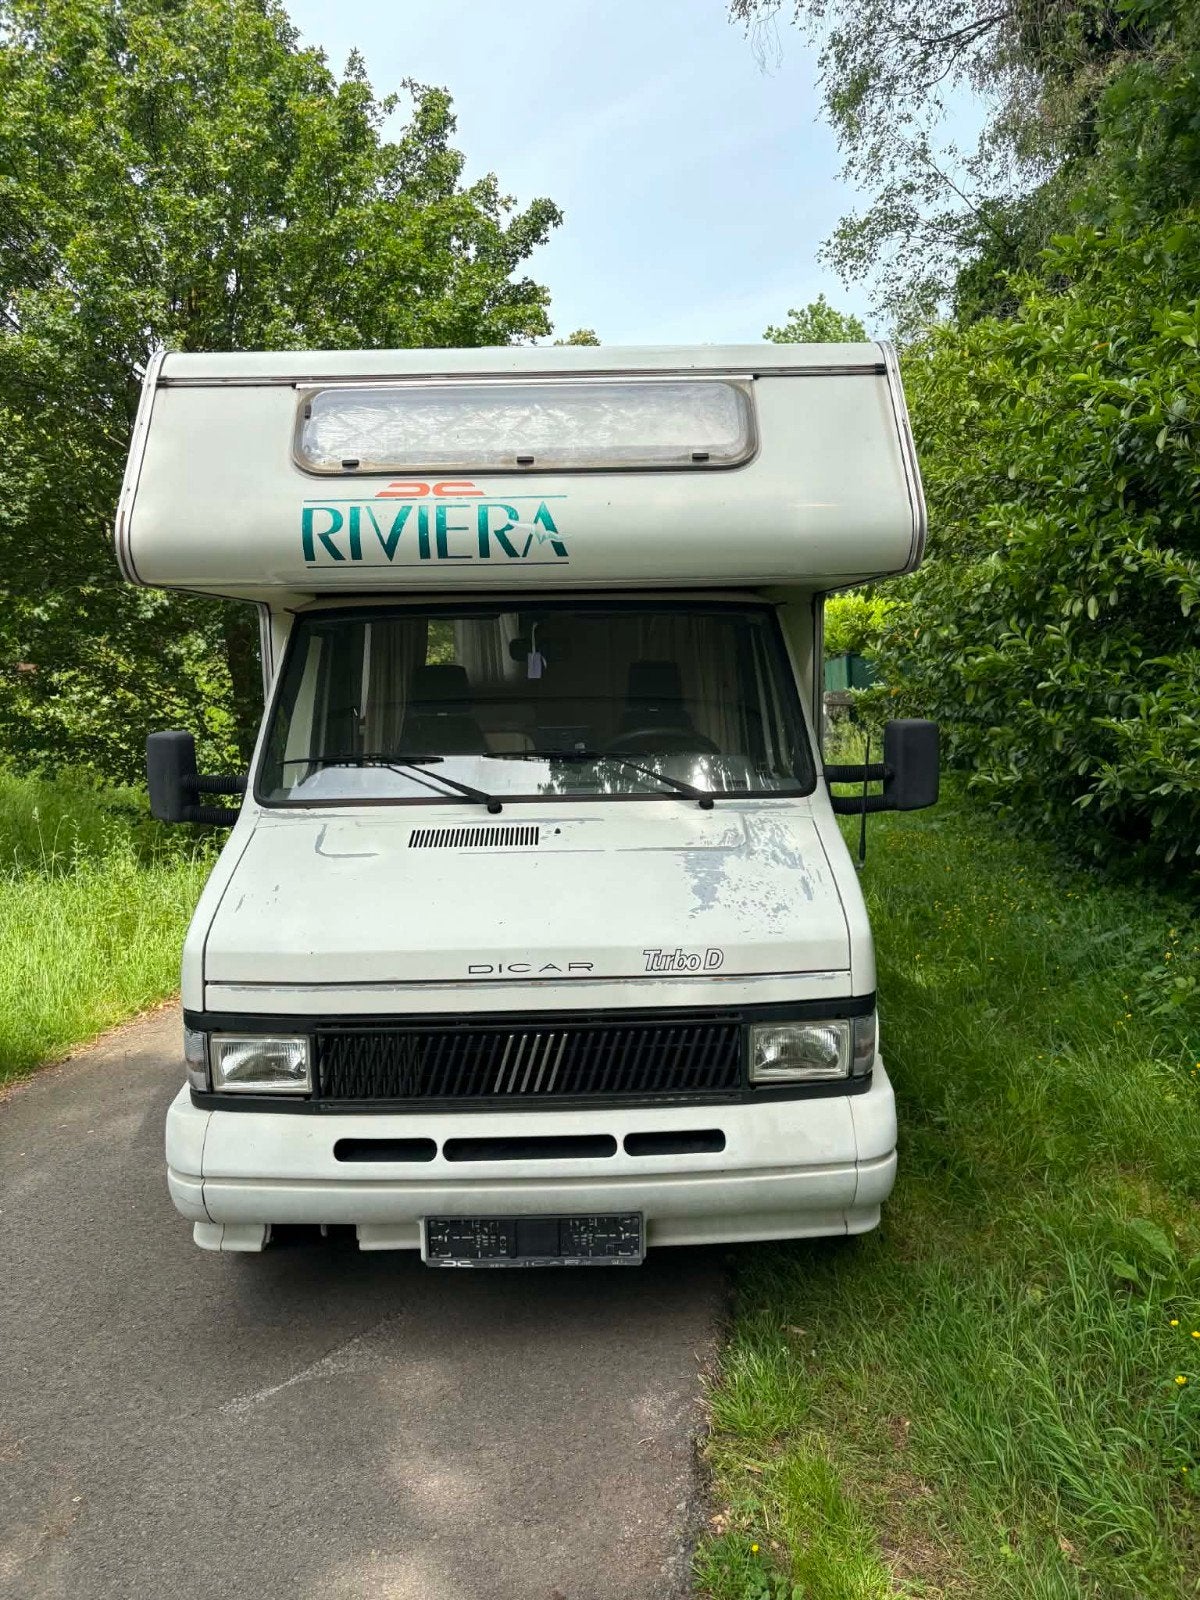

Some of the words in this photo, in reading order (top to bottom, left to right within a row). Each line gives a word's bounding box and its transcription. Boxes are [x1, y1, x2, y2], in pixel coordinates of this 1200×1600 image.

[302, 501, 569, 562] RIVIERA
[468, 962, 594, 974] DICAR
[643, 949, 700, 971] Turbo
[703, 948, 724, 970] D
